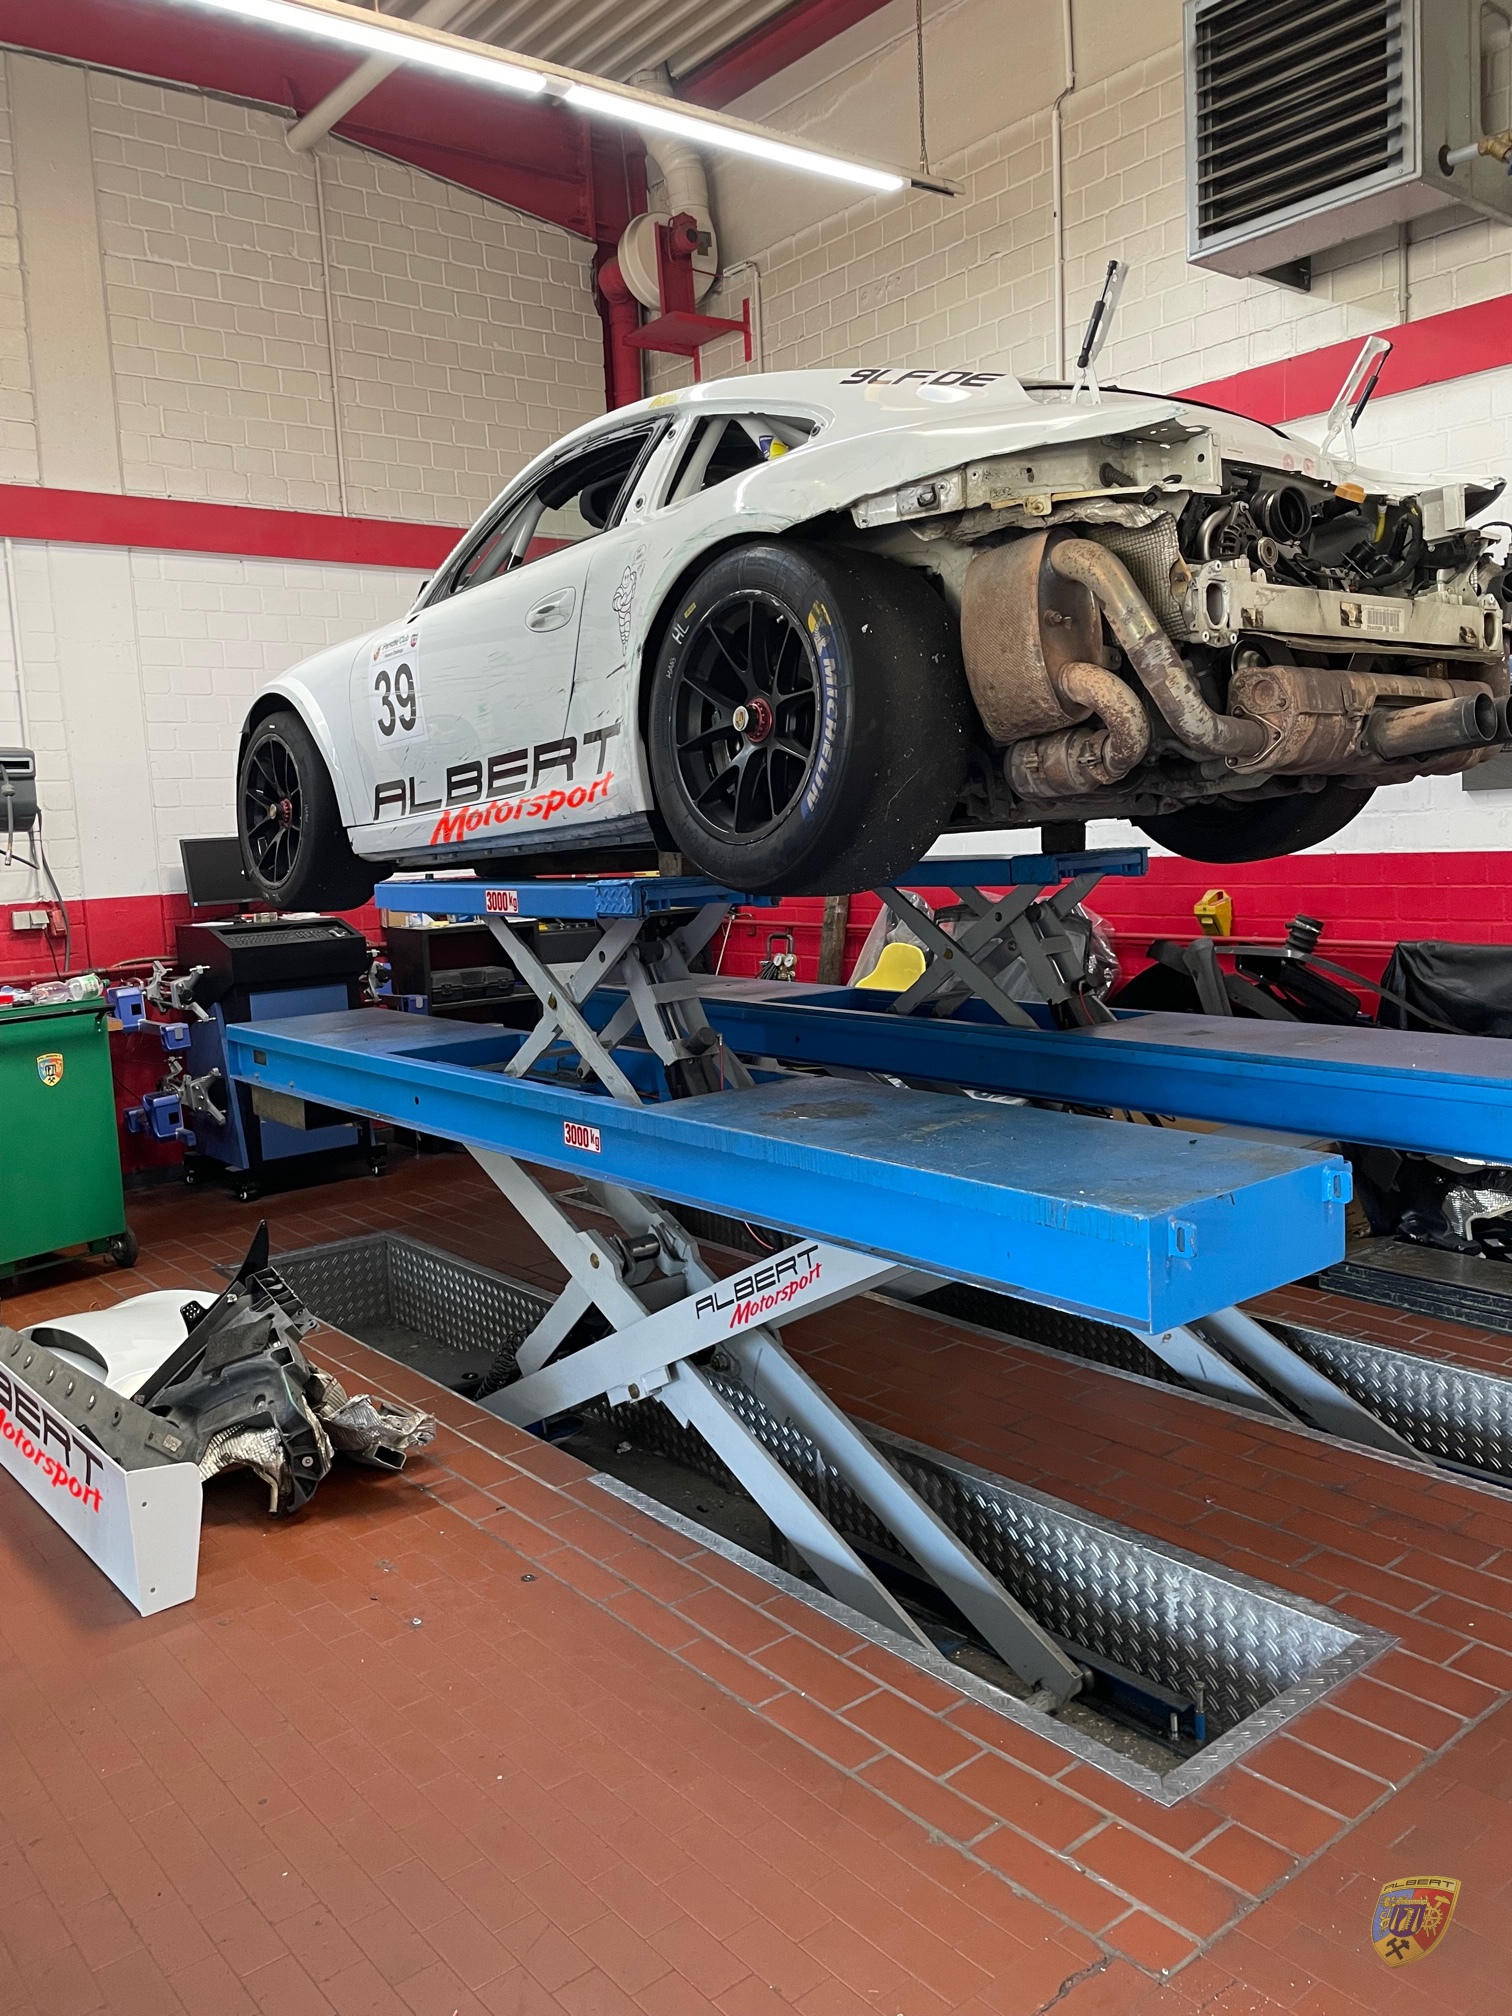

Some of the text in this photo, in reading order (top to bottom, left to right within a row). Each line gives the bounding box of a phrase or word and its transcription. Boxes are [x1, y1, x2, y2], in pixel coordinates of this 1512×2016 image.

[374, 663, 417, 737] 39
[806, 658, 838, 812] MICHELIN
[373, 721, 622, 821] ALBERT
[429, 771, 615, 846] Motorsport
[486, 891, 518, 912] 3000 kg
[565, 1123, 600, 1151] 3000 kg
[695, 1244, 819, 1320] ALBERT
[729, 1262, 822, 1329] Motorsport
